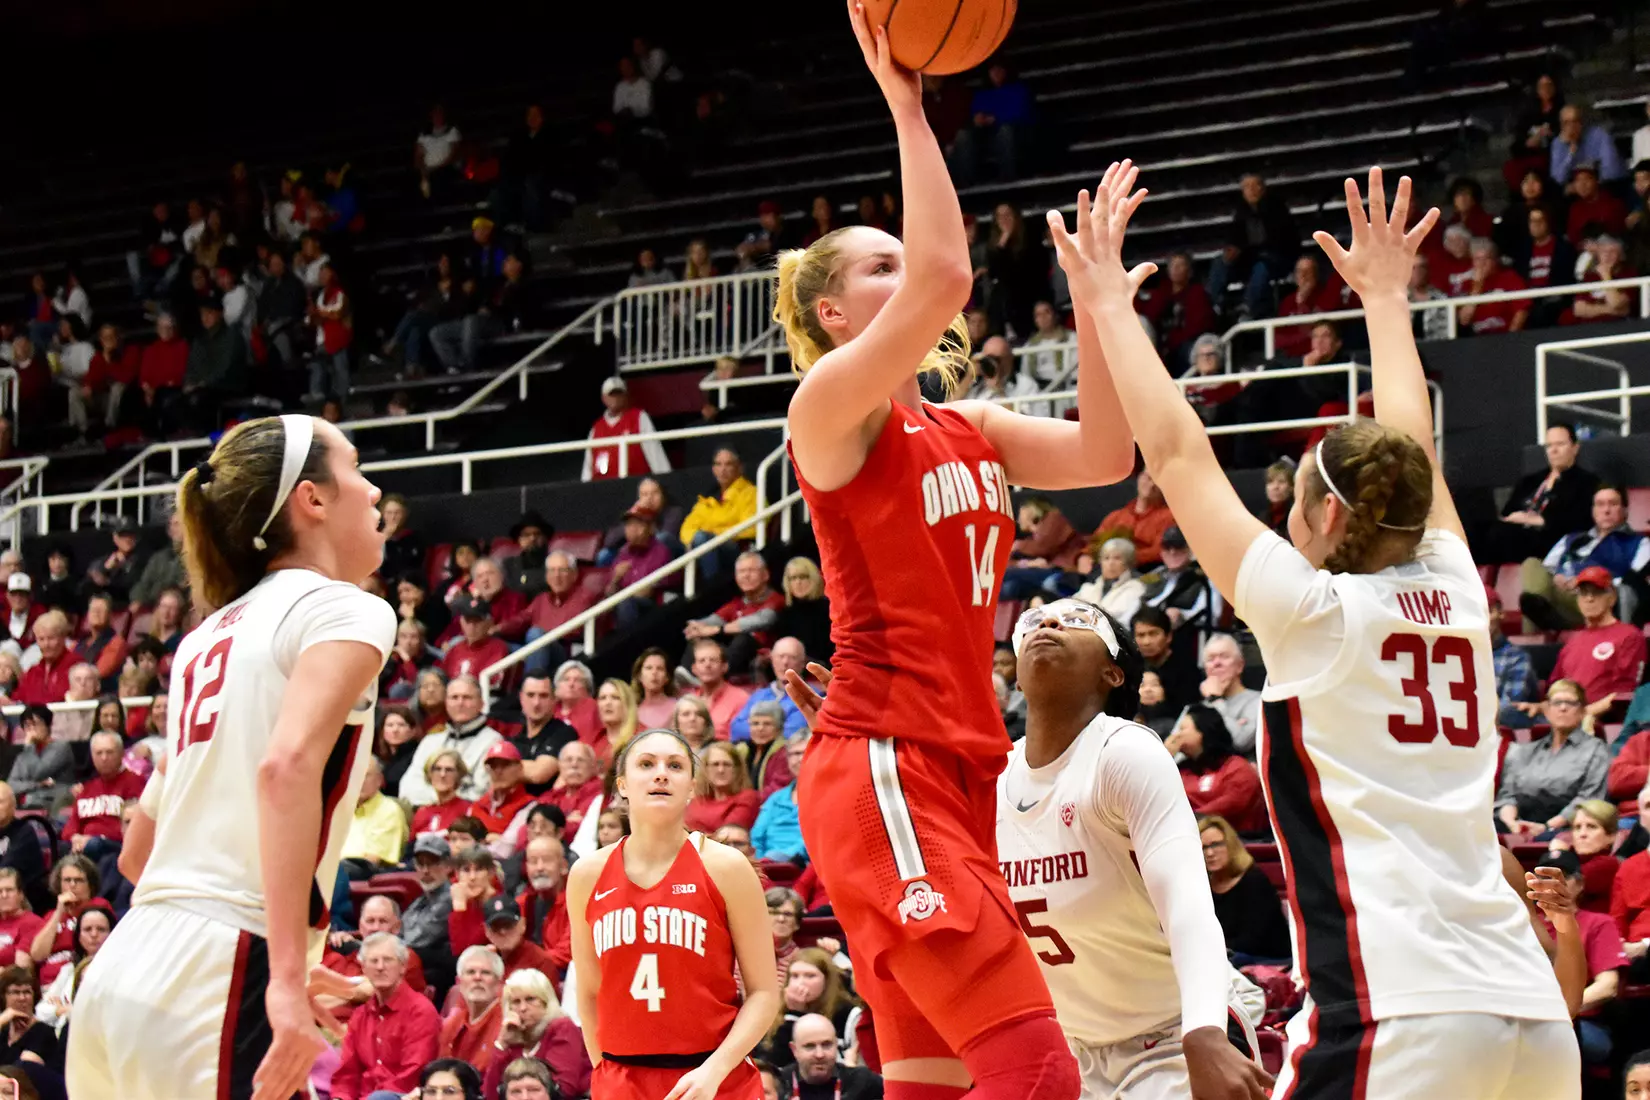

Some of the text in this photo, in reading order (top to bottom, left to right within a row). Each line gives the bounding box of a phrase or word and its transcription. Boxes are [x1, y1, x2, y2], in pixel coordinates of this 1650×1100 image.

[922, 461, 980, 527] OHIO
[964, 523, 1000, 608] 14
[176, 636, 233, 757] 12
[1381, 633, 1480, 748] 33
[999, 850, 1088, 888] ANFORD
[593, 905, 707, 959] OHIO STATE
[1014, 898, 1076, 966] 5
[629, 953, 666, 1012] 4
